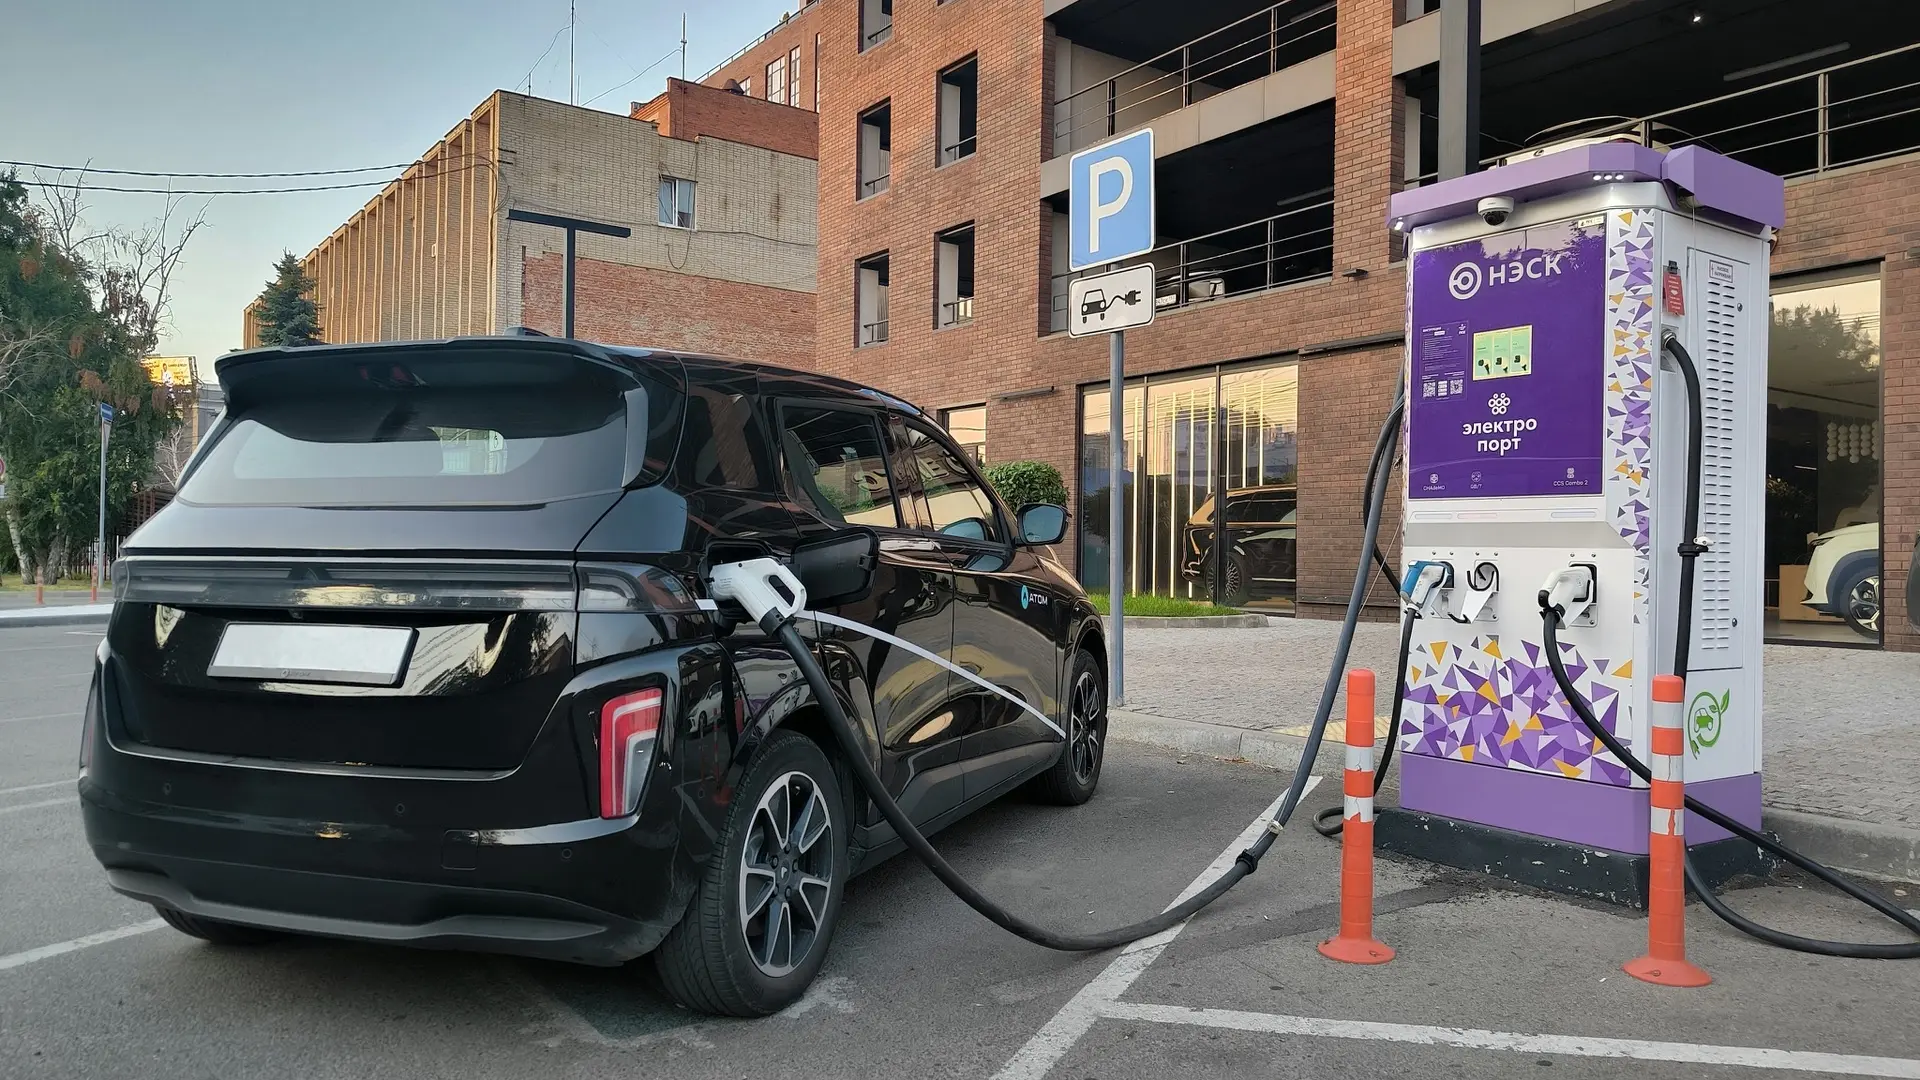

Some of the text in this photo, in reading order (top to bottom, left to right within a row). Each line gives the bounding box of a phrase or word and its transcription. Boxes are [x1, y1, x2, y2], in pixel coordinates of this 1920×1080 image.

[1089, 156, 1133, 254] P
[1489, 254, 1561, 286] НЭСК
[1462, 418, 1538, 437] электро
[1477, 437, 1521, 456] порт
[1029, 593, 1048, 605] ATOM
